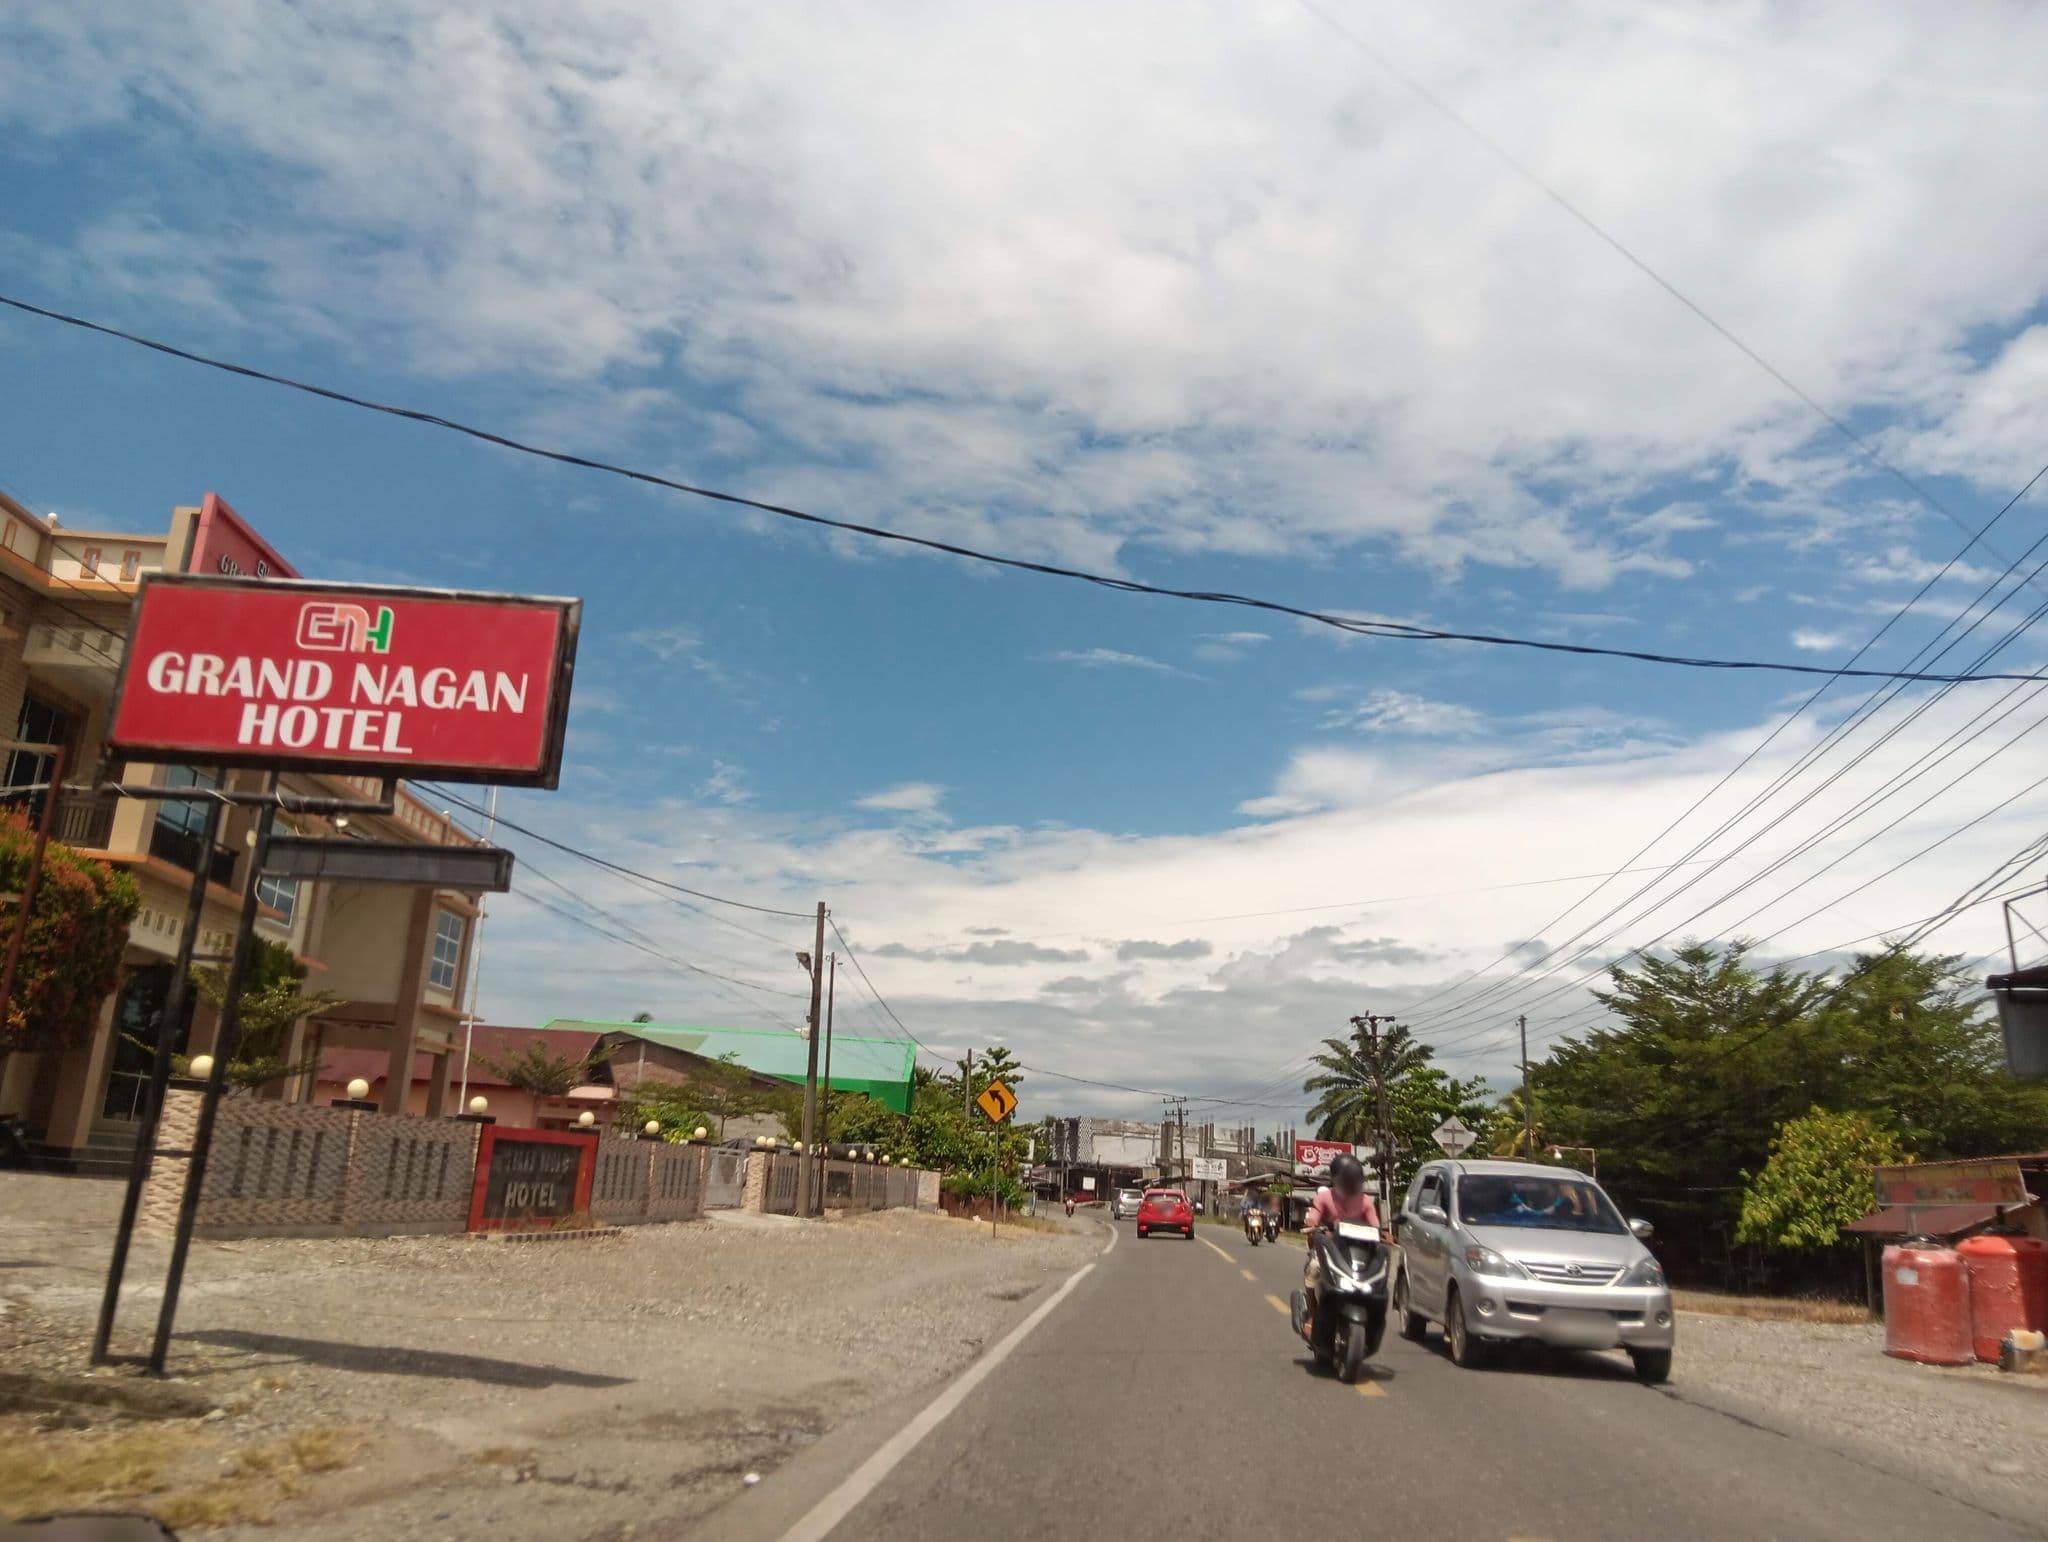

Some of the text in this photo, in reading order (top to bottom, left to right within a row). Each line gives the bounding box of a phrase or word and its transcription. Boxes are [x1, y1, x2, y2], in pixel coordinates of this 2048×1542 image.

[147, 651, 529, 714] GRAND NAGAN
[237, 703, 413, 754] HOTEL
[505, 1182, 556, 1208] HOTEL
